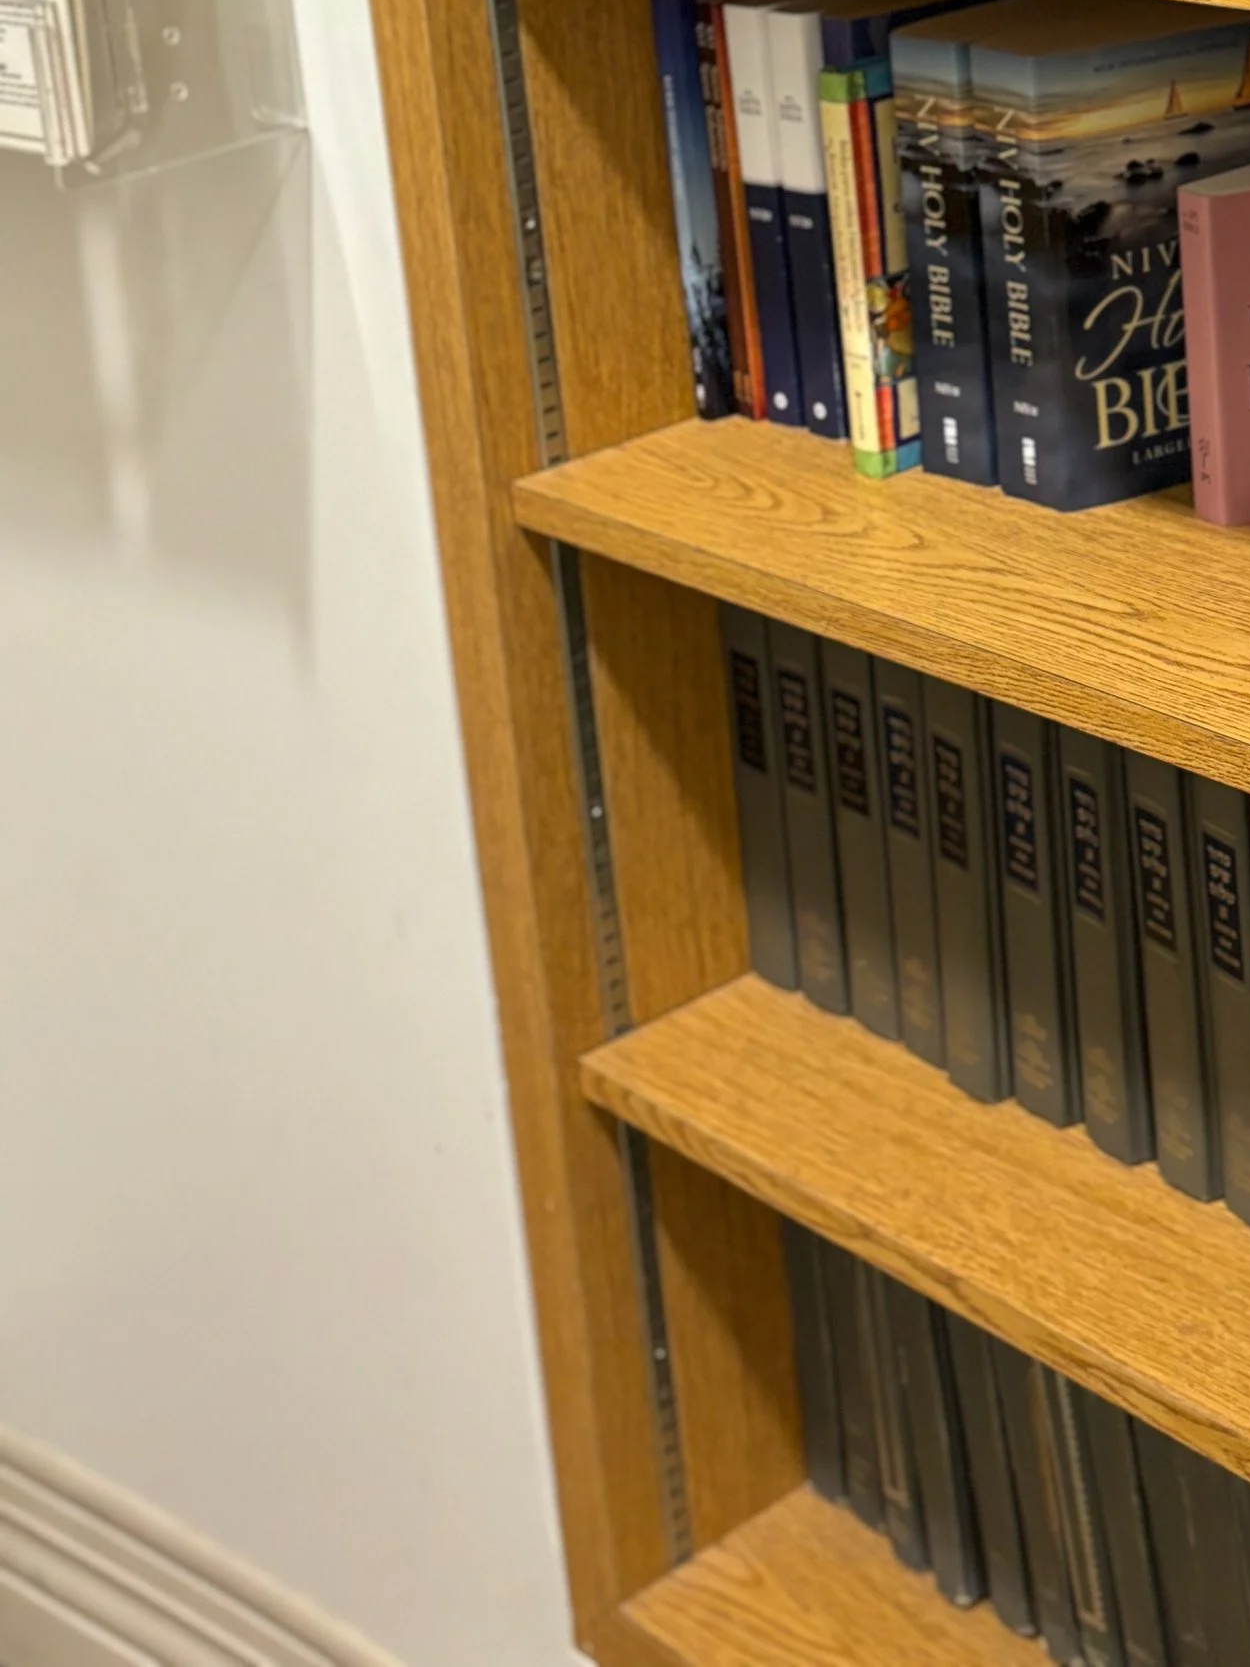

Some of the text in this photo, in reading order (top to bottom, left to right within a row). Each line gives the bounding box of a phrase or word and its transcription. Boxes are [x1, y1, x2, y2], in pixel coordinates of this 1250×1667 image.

[914, 94, 939, 156] NIV
[993, 106, 1018, 171] NIV
[919, 165, 948, 256] HOLY
[999, 179, 1027, 272] HOLY
[1110, 241, 1180, 280] NIV
[926, 264, 955, 347] BIBLE
[1005, 280, 1034, 367] BIBLE
[1075, 270, 1187, 380] Ho
